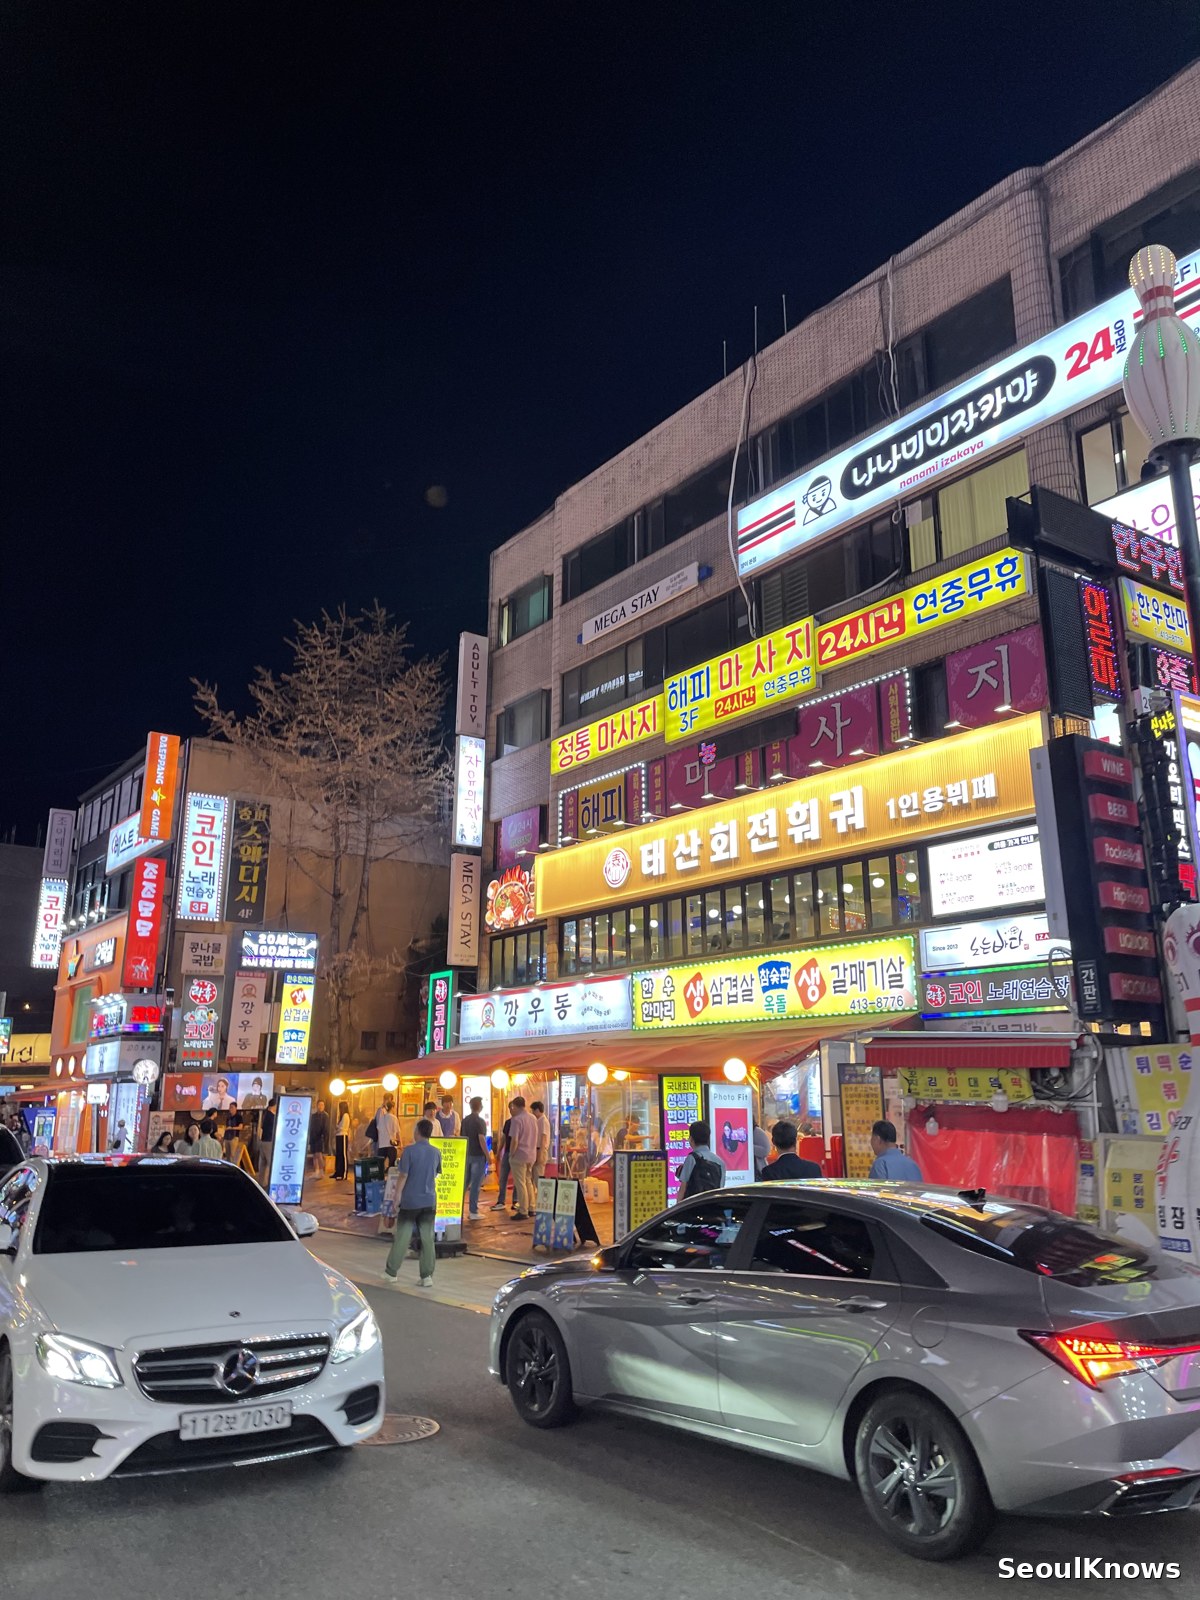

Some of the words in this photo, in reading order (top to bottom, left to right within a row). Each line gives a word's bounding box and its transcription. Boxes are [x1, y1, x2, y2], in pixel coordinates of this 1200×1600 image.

[1065, 326, 1116, 381] 24
[1114, 319, 1127, 354] OPEN
[852, 369, 1039, 487] 나나미이자카야
[900, 461, 939, 488] nanami
[941, 440, 984, 467] izakaya
[913, 556, 1021, 624] 연중무휴
[594, 606, 627, 633] MEGA
[631, 586, 660, 613] STAY
[820, 601, 903, 665] 24시간
[472, 642, 480, 689] ADULT
[668, 666, 710, 712] 해피
[719, 622, 810, 692] 마사지
[716, 688, 755, 716] 24시간
[763, 666, 812, 698] 연중무휴
[470, 694, 478, 723] TOY
[680, 708, 699, 732] 3F
[558, 728, 591, 768] 정통
[598, 700, 657, 751] 마사지
[156, 735, 168, 785] DAEPPANG
[1102, 757, 1126, 776] WINE
[150, 808, 161, 836] GAME
[193, 800, 222, 811] 베스트
[581, 784, 622, 828] 해피
[1107, 801, 1129, 819] BEER
[191, 813, 218, 867] 코인
[185, 886, 215, 900] 연습장
[186, 870, 216, 886] 노래
[462, 860, 474, 905] MEGA
[43, 895, 61, 930] 코인
[192, 902, 208, 912] 3F
[238, 908, 253, 919] 4F
[460, 912, 473, 949] STAY
[932, 944, 945, 952] Since
[946, 943, 959, 951] 2013
[189, 942, 222, 954] 콩나물
[191, 955, 214, 967] 국밥
[686, 982, 706, 1012] 생
[709, 973, 755, 1006] 삼겹살
[797, 965, 821, 1003] 생
[830, 956, 905, 995] 갈매기살
[949, 980, 983, 1005] 코인
[987, 976, 1069, 1001] 노래연습장
[504, 993, 572, 1027] 깡우동
[641, 1000, 676, 1022] 한마리
[763, 993, 788, 1014] 옥돌
[850, 995, 904, 1011] 413-8776
[184, 1023, 215, 1040] 코인
[237, 1002, 255, 1050] 깡우동
[434, 1004, 446, 1051] 코인
[667, 1081, 697, 1092] 국내최대
[667, 1093, 698, 1108] 성생활
[713, 1093, 735, 1101] Photo
[737, 1093, 748, 1101] Fit
[667, 1109, 698, 1124] 편의점
[279, 1118, 303, 1182] 깡우동
